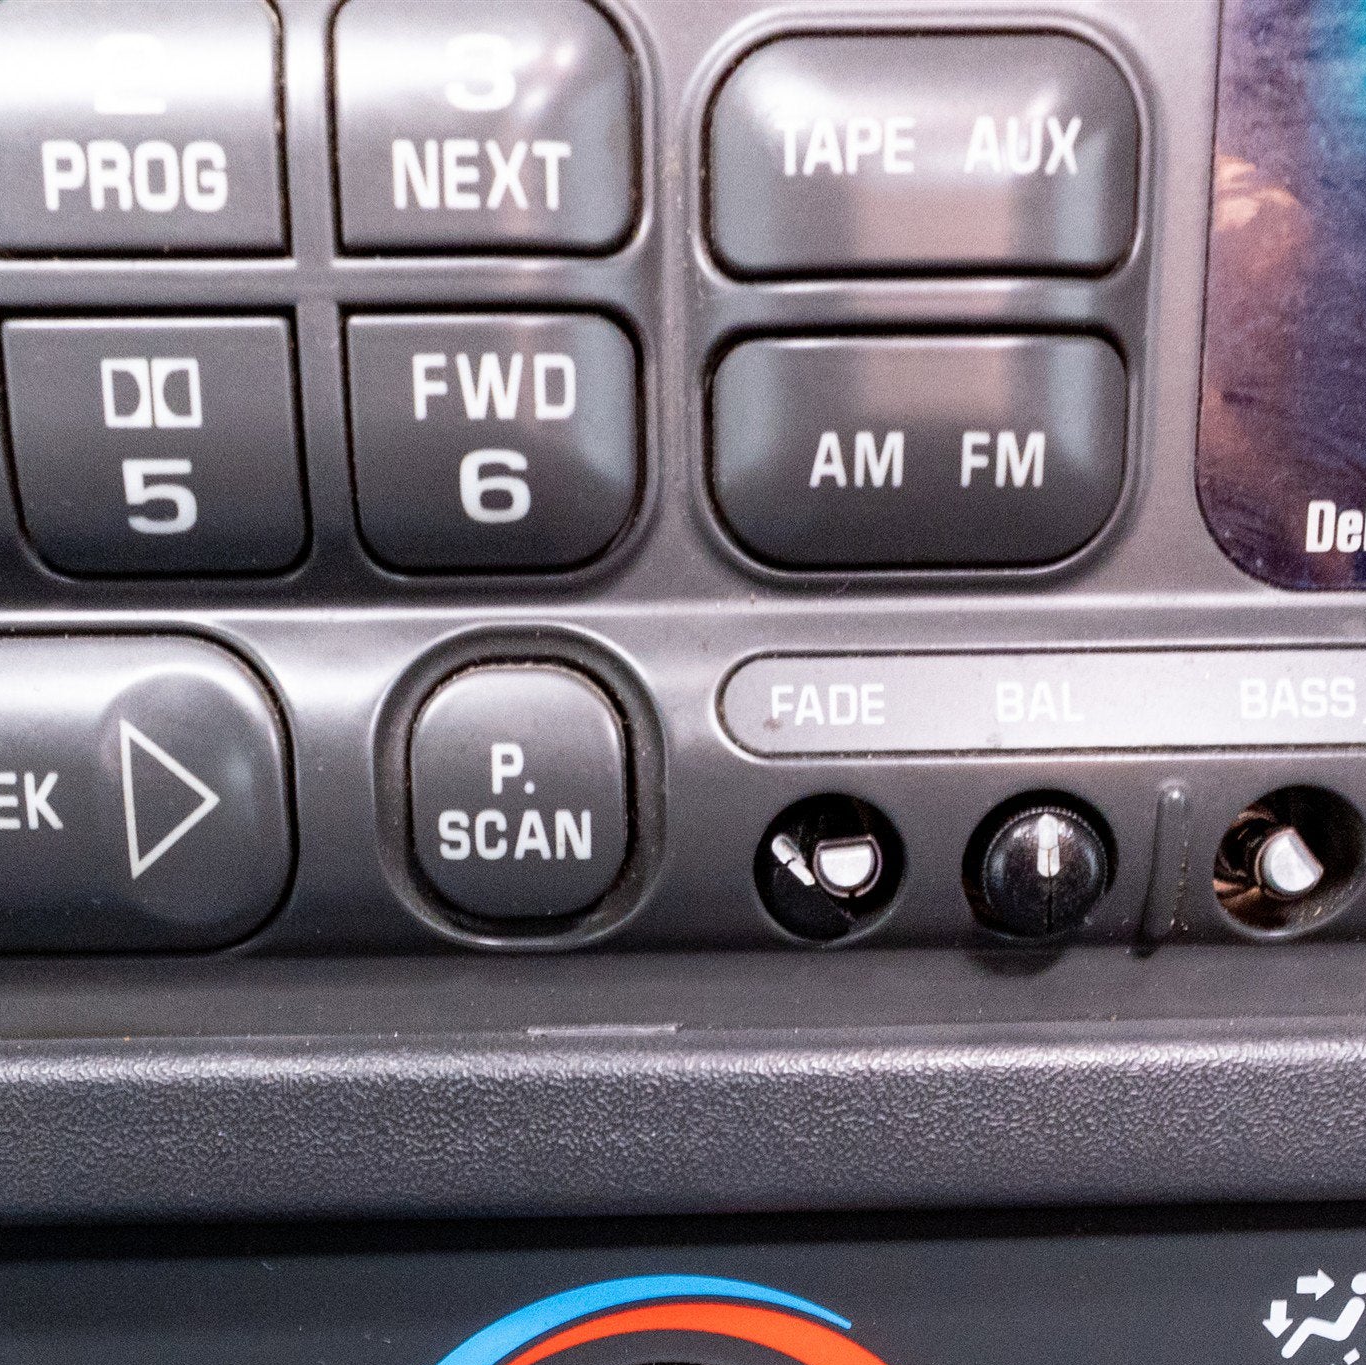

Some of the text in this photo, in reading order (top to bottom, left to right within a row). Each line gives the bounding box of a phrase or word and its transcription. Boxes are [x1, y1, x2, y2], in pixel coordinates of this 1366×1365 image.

[444, 33, 518, 112] 3
[41, 140, 228, 212] PROG
[392, 139, 571, 211] NEXT
[773, 114, 1083, 176] TAPE AUX
[412, 352, 577, 420] FWD
[459, 448, 531, 522] 6
[810, 430, 1046, 487] AM FM
[122, 459, 197, 533] 5
[770, 683, 885, 726] FADE
[994, 681, 1085, 724] BAL
[1238, 677, 1357, 720] BASS
[490, 741, 535, 794] P.
[438, 809, 592, 860] SCAN
